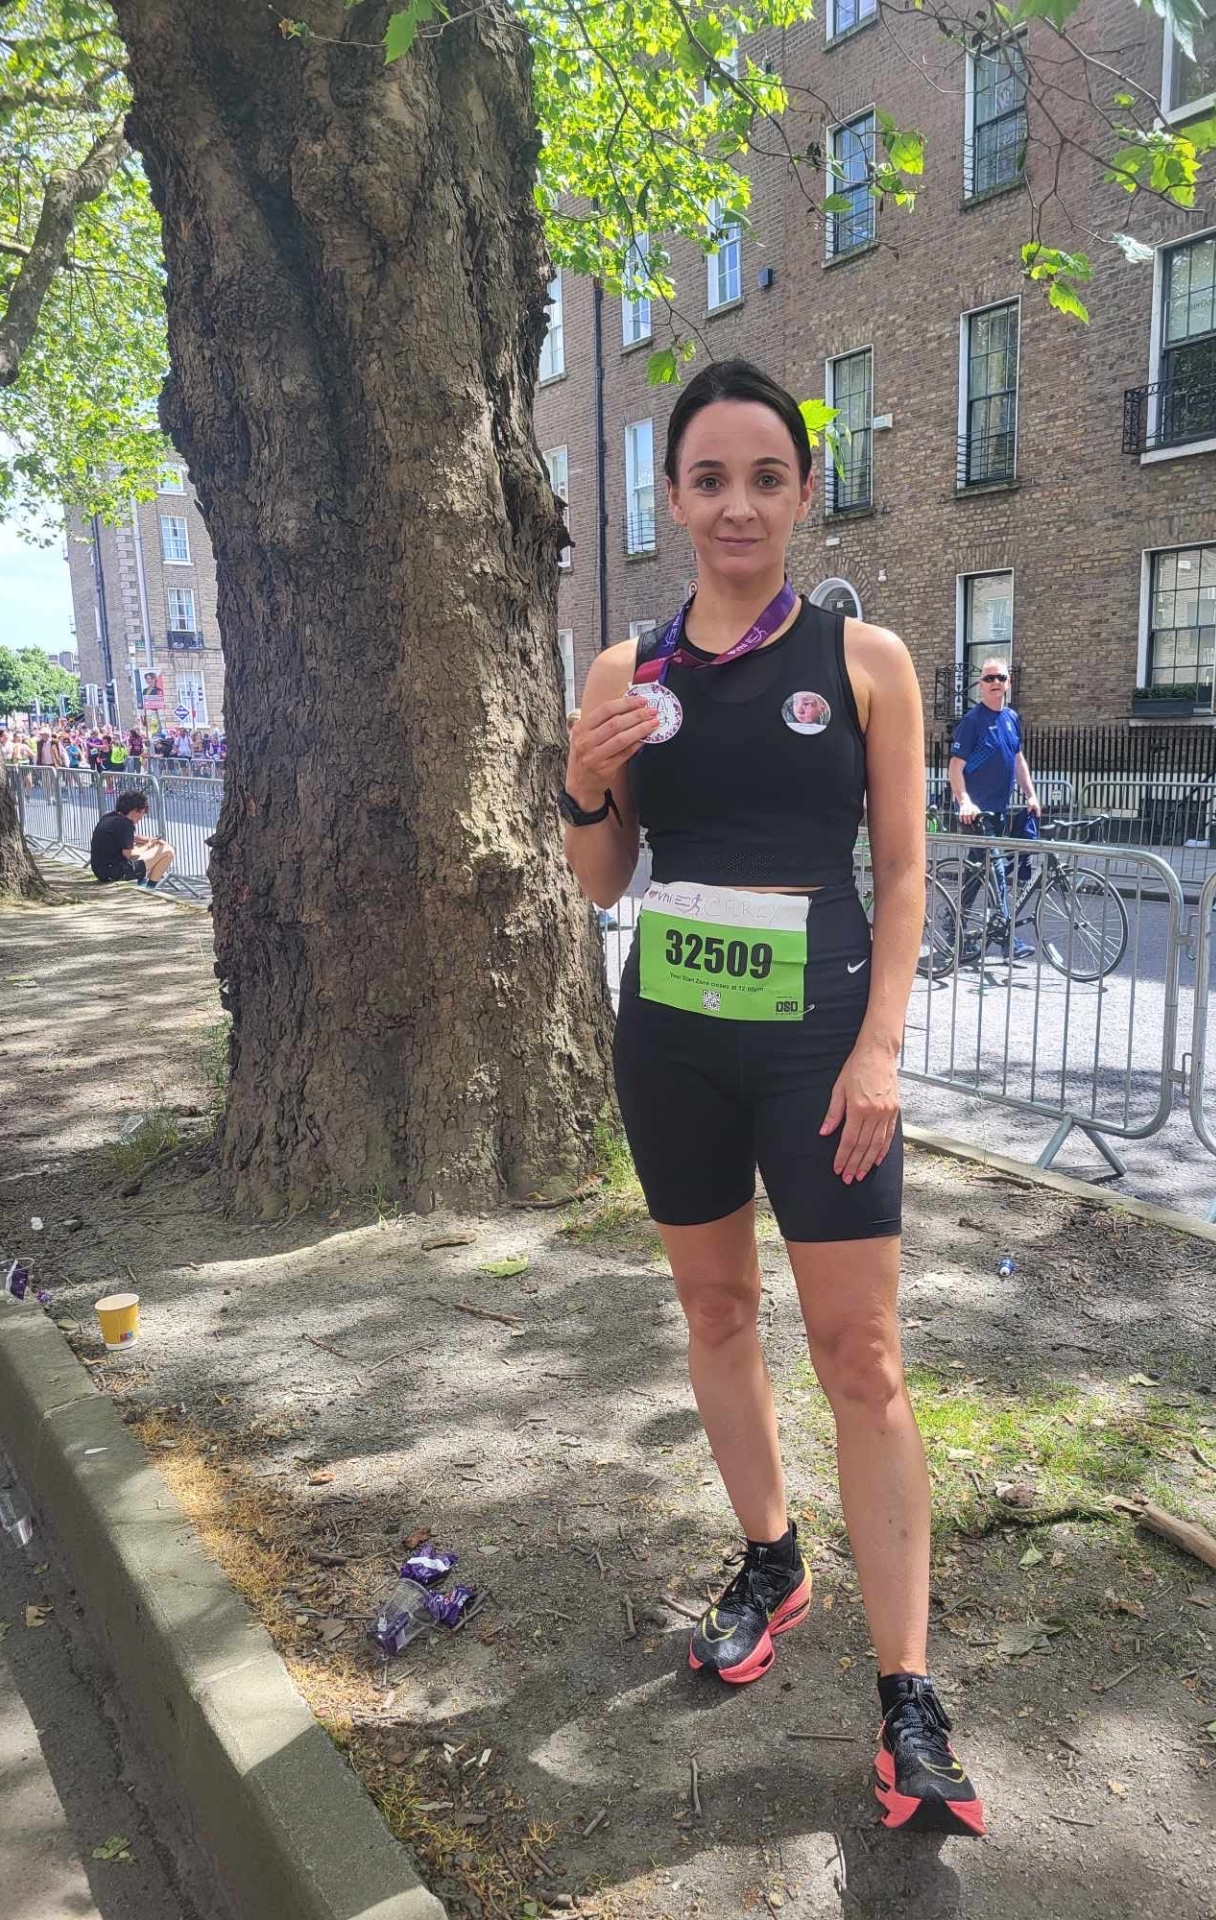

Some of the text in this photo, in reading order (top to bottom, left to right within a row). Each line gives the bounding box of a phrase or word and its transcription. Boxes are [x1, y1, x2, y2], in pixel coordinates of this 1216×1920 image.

[666, 929, 772, 979] 32509
[682, 974, 695, 984] Start
[695, 977, 709, 986] Zone
[776, 1001, 798, 1012] DSD
